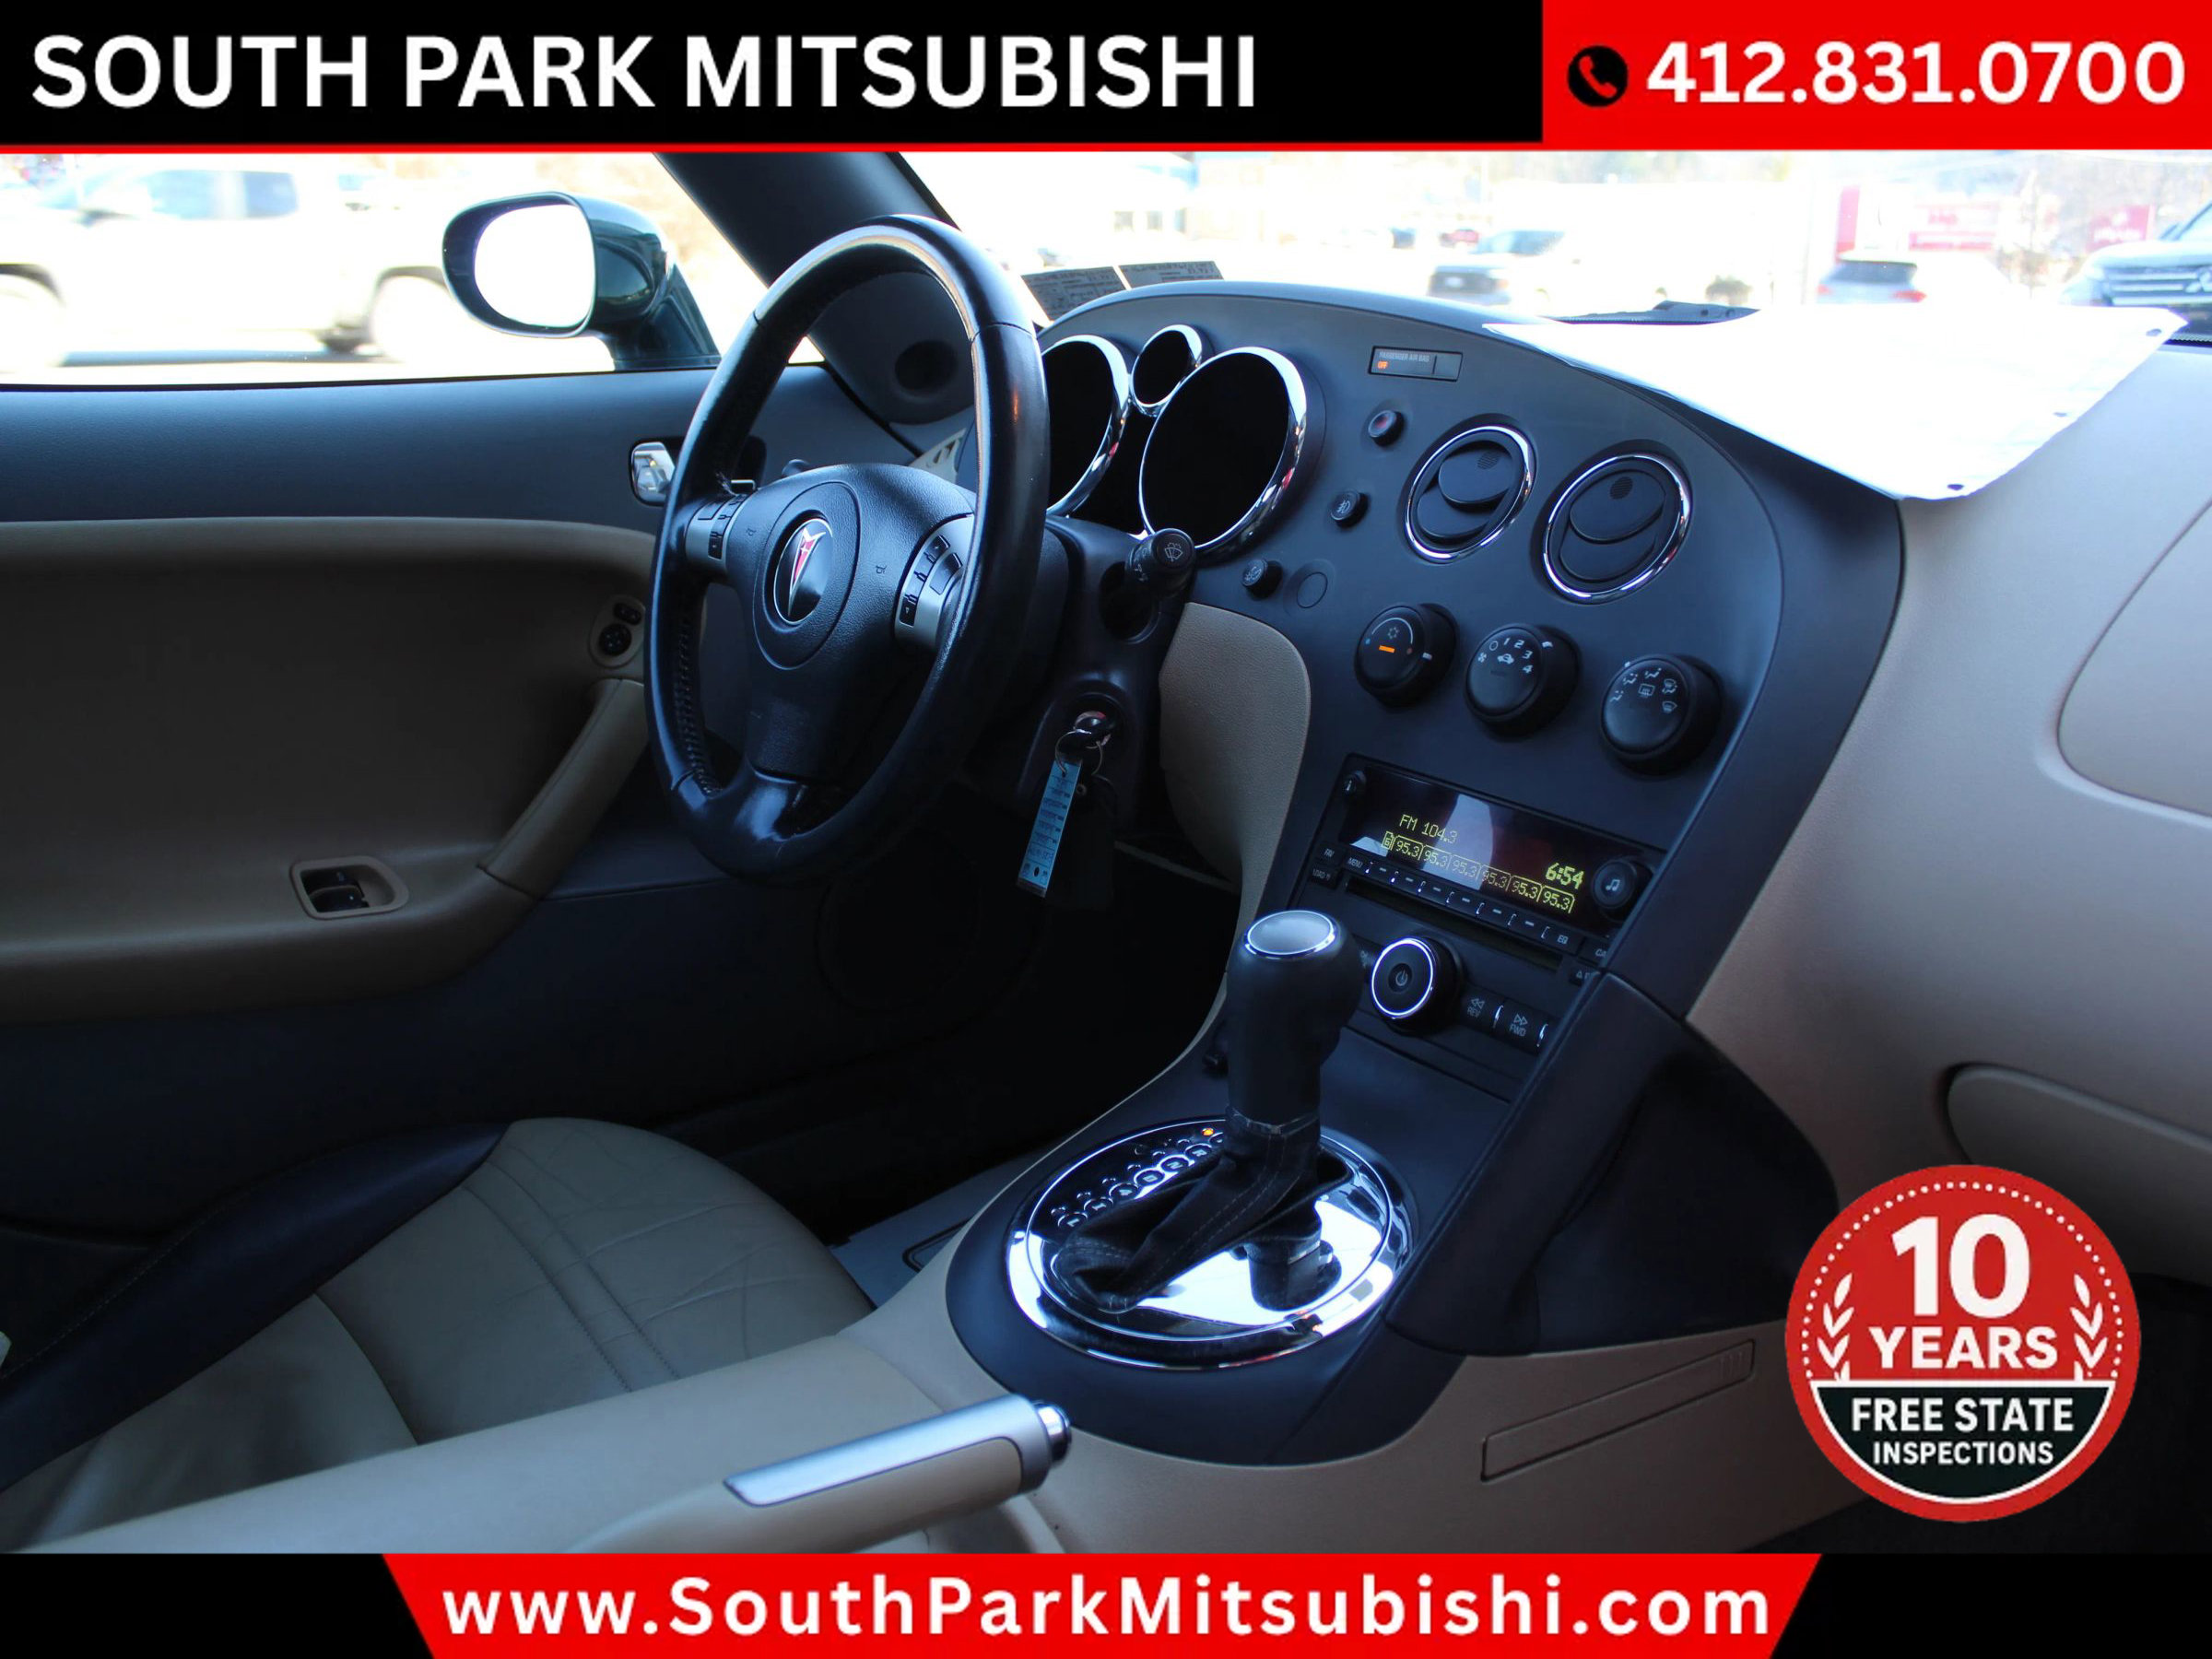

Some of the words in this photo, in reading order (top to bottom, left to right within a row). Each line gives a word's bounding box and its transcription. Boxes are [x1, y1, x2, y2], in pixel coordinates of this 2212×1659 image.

[1513, 639, 1524, 649] 2
[1522, 650, 1533, 659] 3
[1523, 665, 1533, 674] 4
[1399, 814, 1418, 831] FM
[1421, 821, 1458, 844] 104.3
[1395, 840, 1420, 858] 95.3
[1423, 849, 1449, 868] 95.3
[1452, 859, 1477, 878] 95.3
[1481, 869, 1508, 888] 95.3
[1512, 880, 1538, 900] 95.3
[1542, 890, 1571, 911] 95.3
[1545, 862, 1584, 890] 6:54
